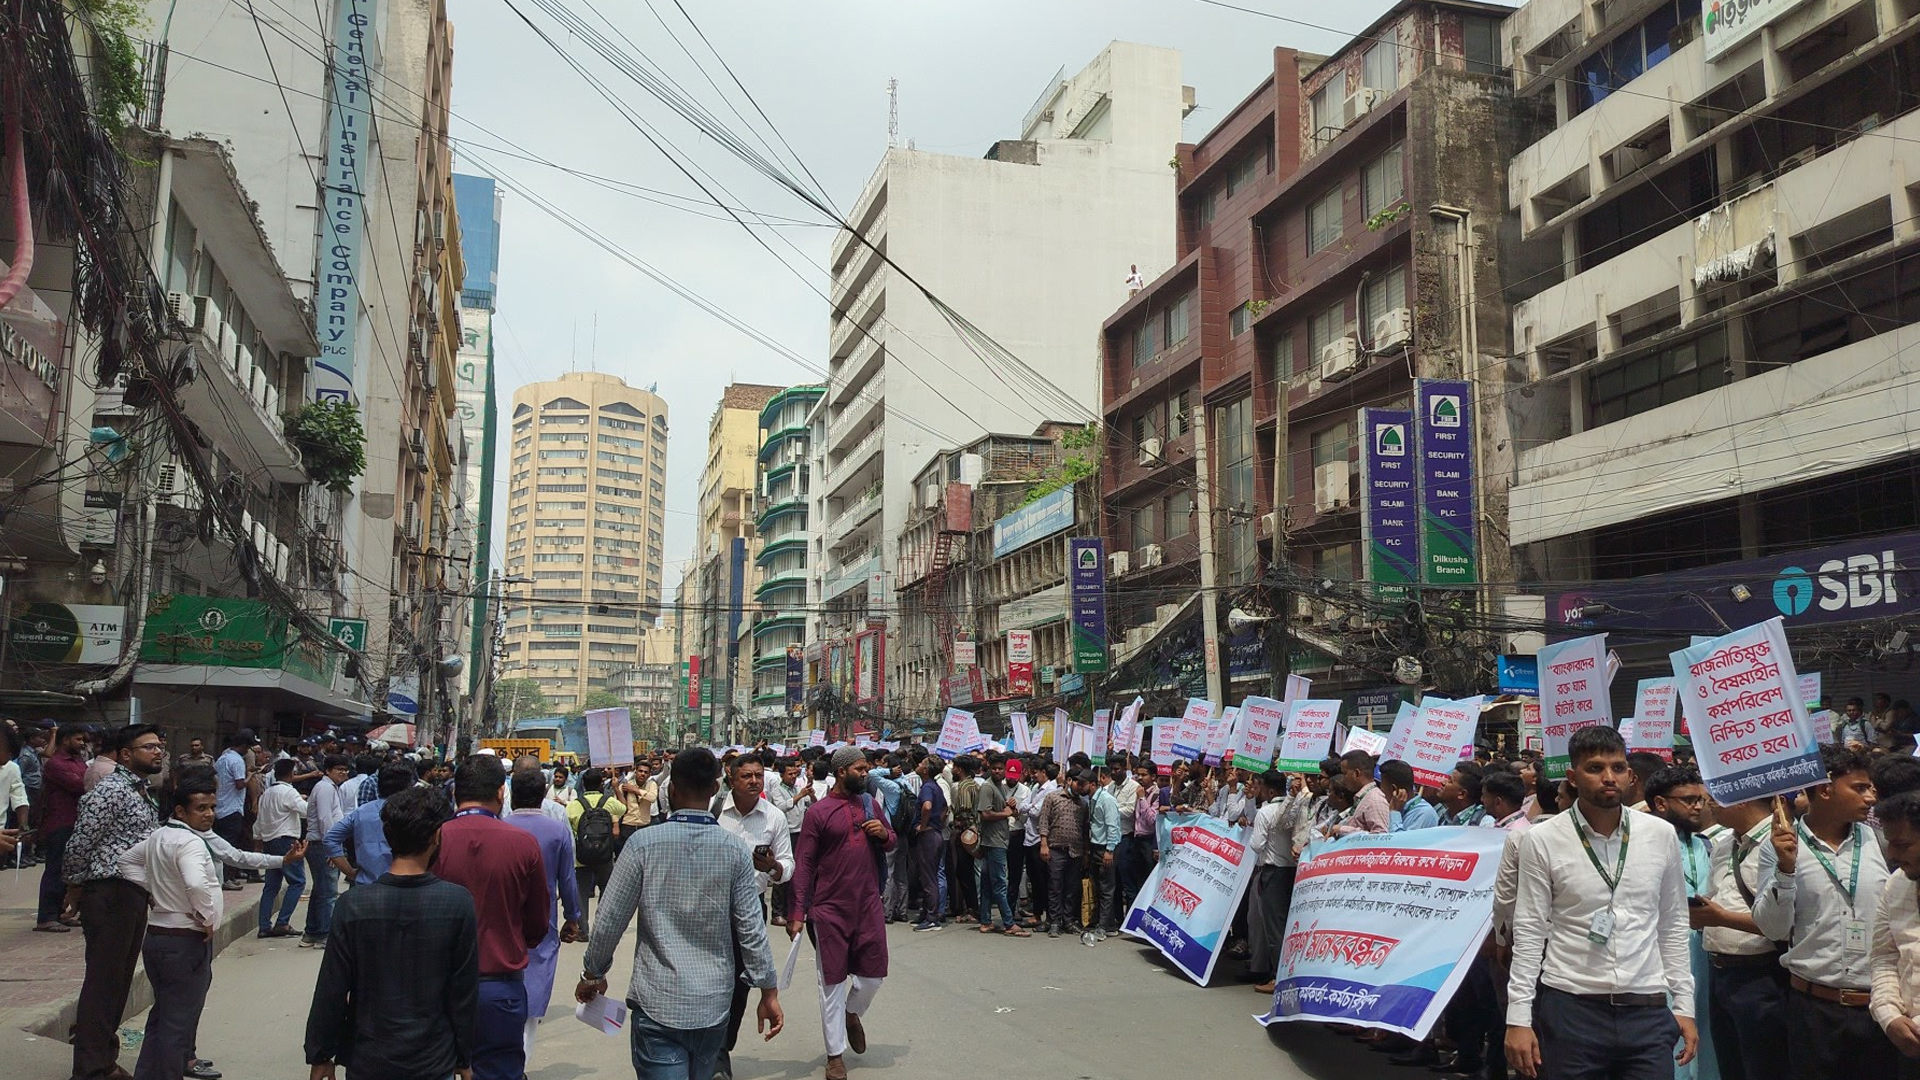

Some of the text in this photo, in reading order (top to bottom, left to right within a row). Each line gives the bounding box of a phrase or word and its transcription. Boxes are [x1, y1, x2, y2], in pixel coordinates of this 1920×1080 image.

[327, 13, 368, 342] General Insurance Company
[323, 345, 347, 355] PLC
[1428, 451, 1465, 460] SECURITY
[1434, 471, 1460, 479] ISLAMI
[1374, 480, 1409, 489] SECURITY
[1437, 490, 1459, 498] BANK
[1380, 500, 1405, 508] ISLAMI
[1382, 519, 1404, 527] BANK
[1433, 555, 1468, 564] Dilkusha
[1436, 566, 1466, 575] Branch
[1819, 550, 1897, 611] SBI
[90, 623, 117, 632] ATM
[1689, 640, 1771, 677] রাজনীতিমুক্ত
[1698, 685, 1709, 699] ও
[1710, 662, 1780, 694] বৈষম্যহীন
[1557, 680, 1587, 695] রক্ত ঘাম
[1357, 694, 1389, 704] ATM BOOTH
[1707, 686, 1783, 719] কর্মপরিবেশ
[1577, 699, 1593, 712] করে
[1710, 719, 1756, 744] নিশ্চিত
[1758, 709, 1794, 729] করো
[1718, 743, 1759, 765] করতে
[1391, 851, 1418, 868] বিরুদ্ধে
[1418, 855, 1437, 869] রুখে
